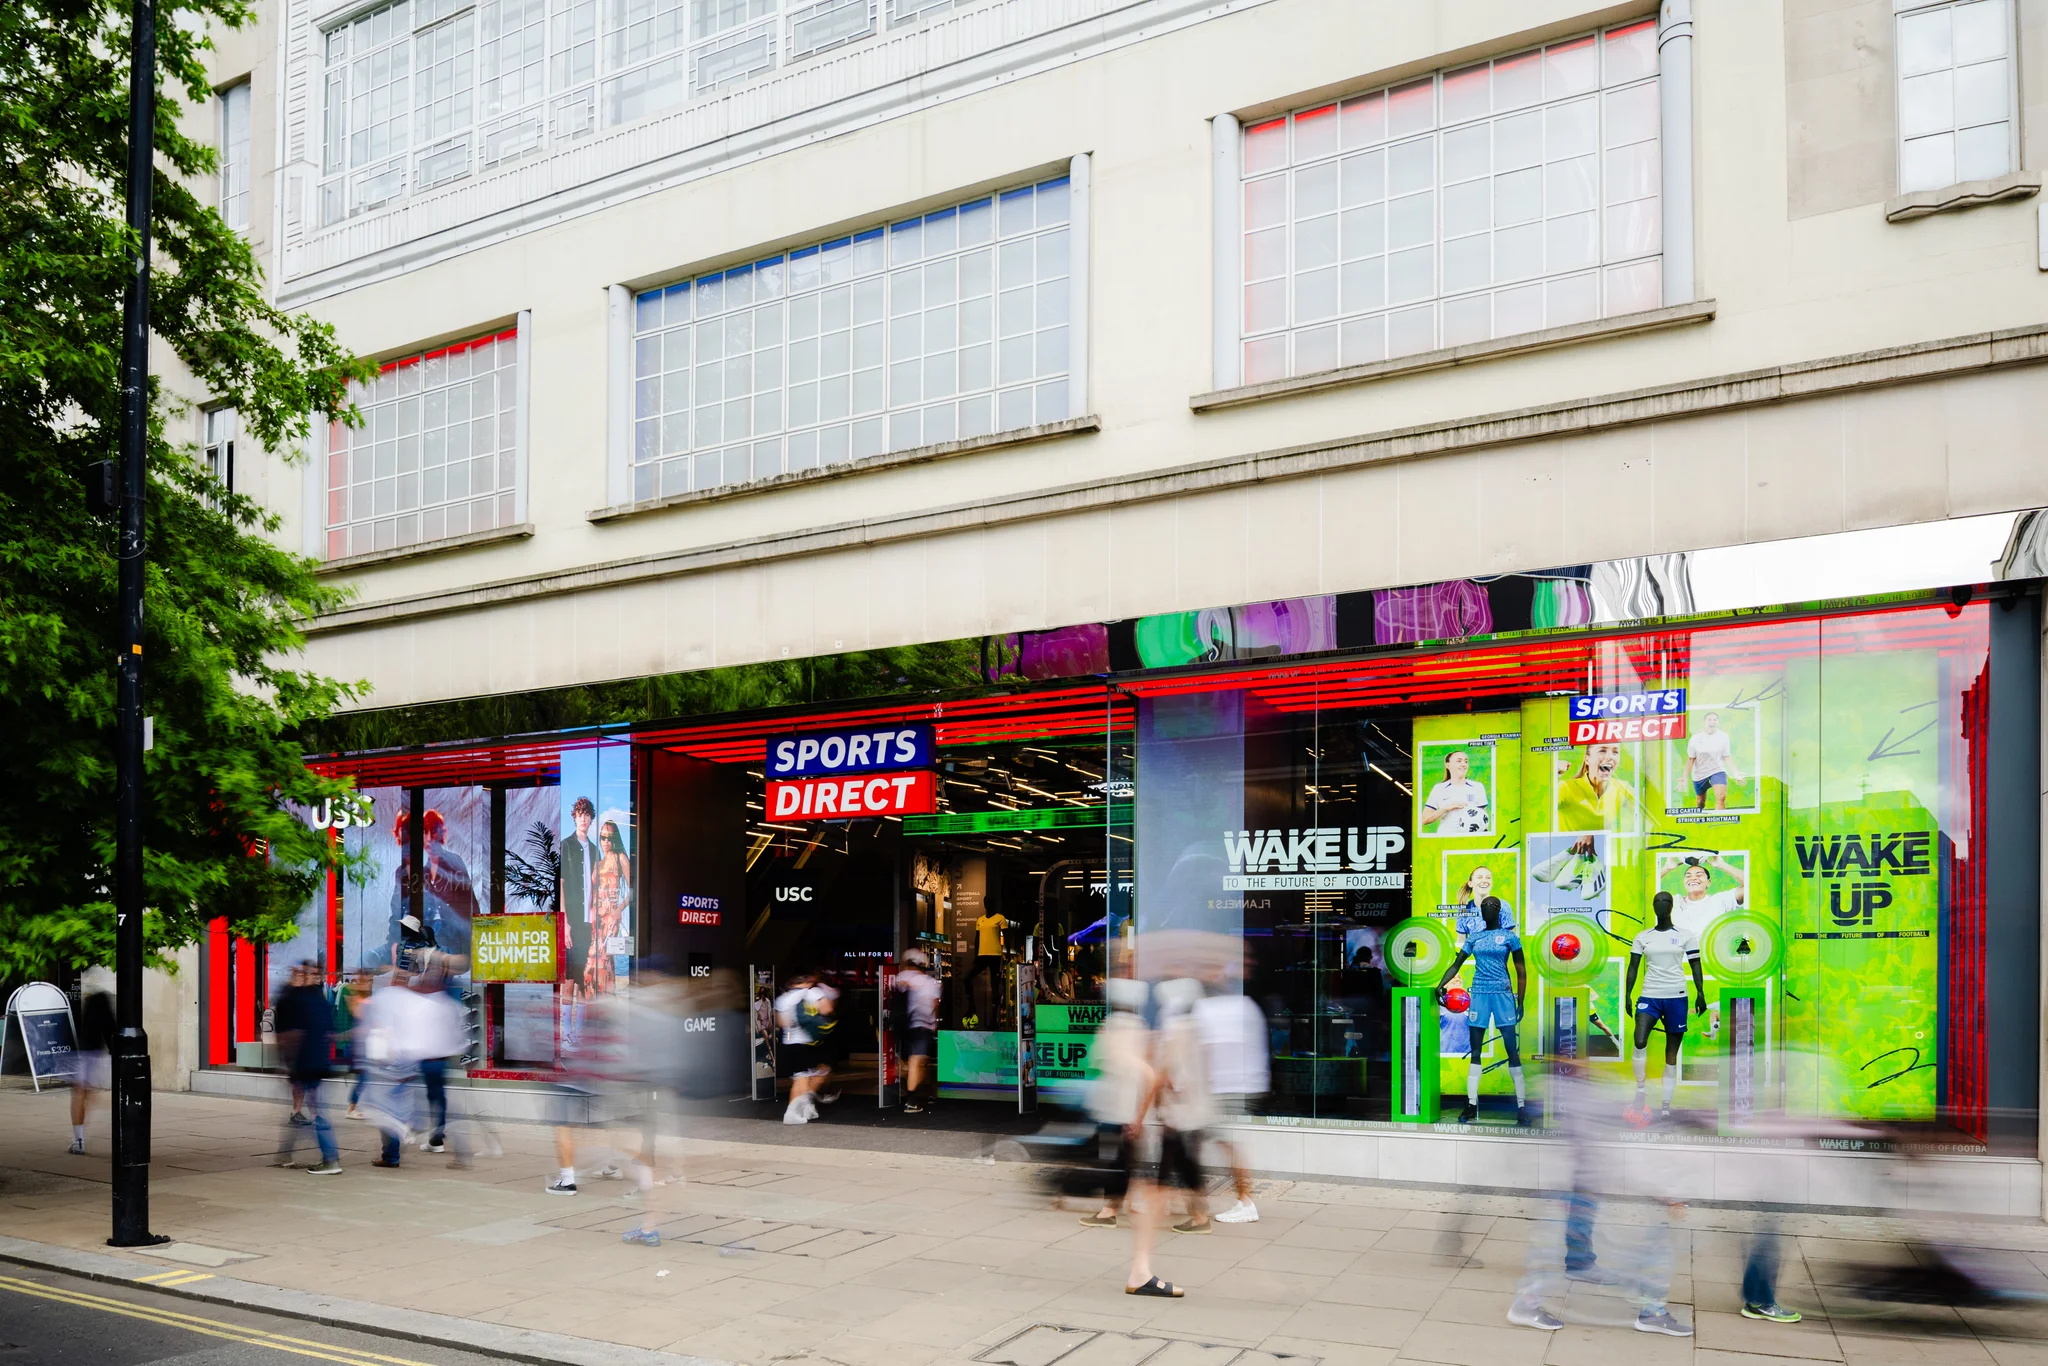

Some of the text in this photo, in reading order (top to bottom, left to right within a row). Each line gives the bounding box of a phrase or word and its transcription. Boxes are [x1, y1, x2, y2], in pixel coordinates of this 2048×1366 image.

[1576, 691, 1679, 717] SPORTS
[1576, 717, 1679, 742] DIRECT
[775, 730, 917, 772] SPORTS
[775, 776, 916, 816] DIRECT
[1224, 826, 1405, 872] WAKE UP
[1795, 831, 1930, 878] WAKE
[1226, 875, 1401, 888] TO THE FUTURE OF FOOTBALL
[775, 887, 813, 902] USC
[681, 895, 719, 909] SPORTS
[1354, 902, 1389, 910] STORE
[1831, 882, 1893, 926] UP
[118, 914, 127, 926] 7
[681, 911, 718, 924] DIRECT
[1354, 909, 1388, 917] GUIDE
[479, 931, 549, 945] ALL IN FOR
[478, 945, 550, 964] SUMMER
[690, 966, 710, 977] USC
[684, 1017, 716, 1032] GAME
[51, 1045, 71, 1054] £329
[1058, 1043, 1087, 1068] UP
[1266, 1115, 1289, 1126] WAKE
[1289, 1116, 1300, 1126] UP
[1304, 1118, 1311, 1126] TO
[1328, 1119, 1352, 1128] FUTURE
[1354, 1120, 1363, 1128] OF
[1364, 1121, 1398, 1129] FOOTBALL
[1434, 1123, 1459, 1133] WAKE
[1459, 1123, 1471, 1134] UP
[1475, 1126, 1483, 1134] TO
[1485, 1126, 1499, 1134] THE
[1501, 1127, 1529, 1136] FUTURE
[1531, 1128, 1540, 1136] OF
[1620, 1131, 1646, 1142] WAKE
[1647, 1133, 1660, 1143] UP
[1677, 1135, 1692, 1143] THE
[1694, 1135, 1724, 1144] FUTURE
[1727, 1137, 1737, 1145] OF
[1740, 1137, 1781, 1147] FOOTBALL
[1820, 1138, 1850, 1149] WAKE
[1850, 1139, 1865, 1150] UP
[1869, 1142, 1880, 1150] TO
[1883, 1142, 1900, 1150] THE
[1902, 1144, 1936, 1152] FUTURE
